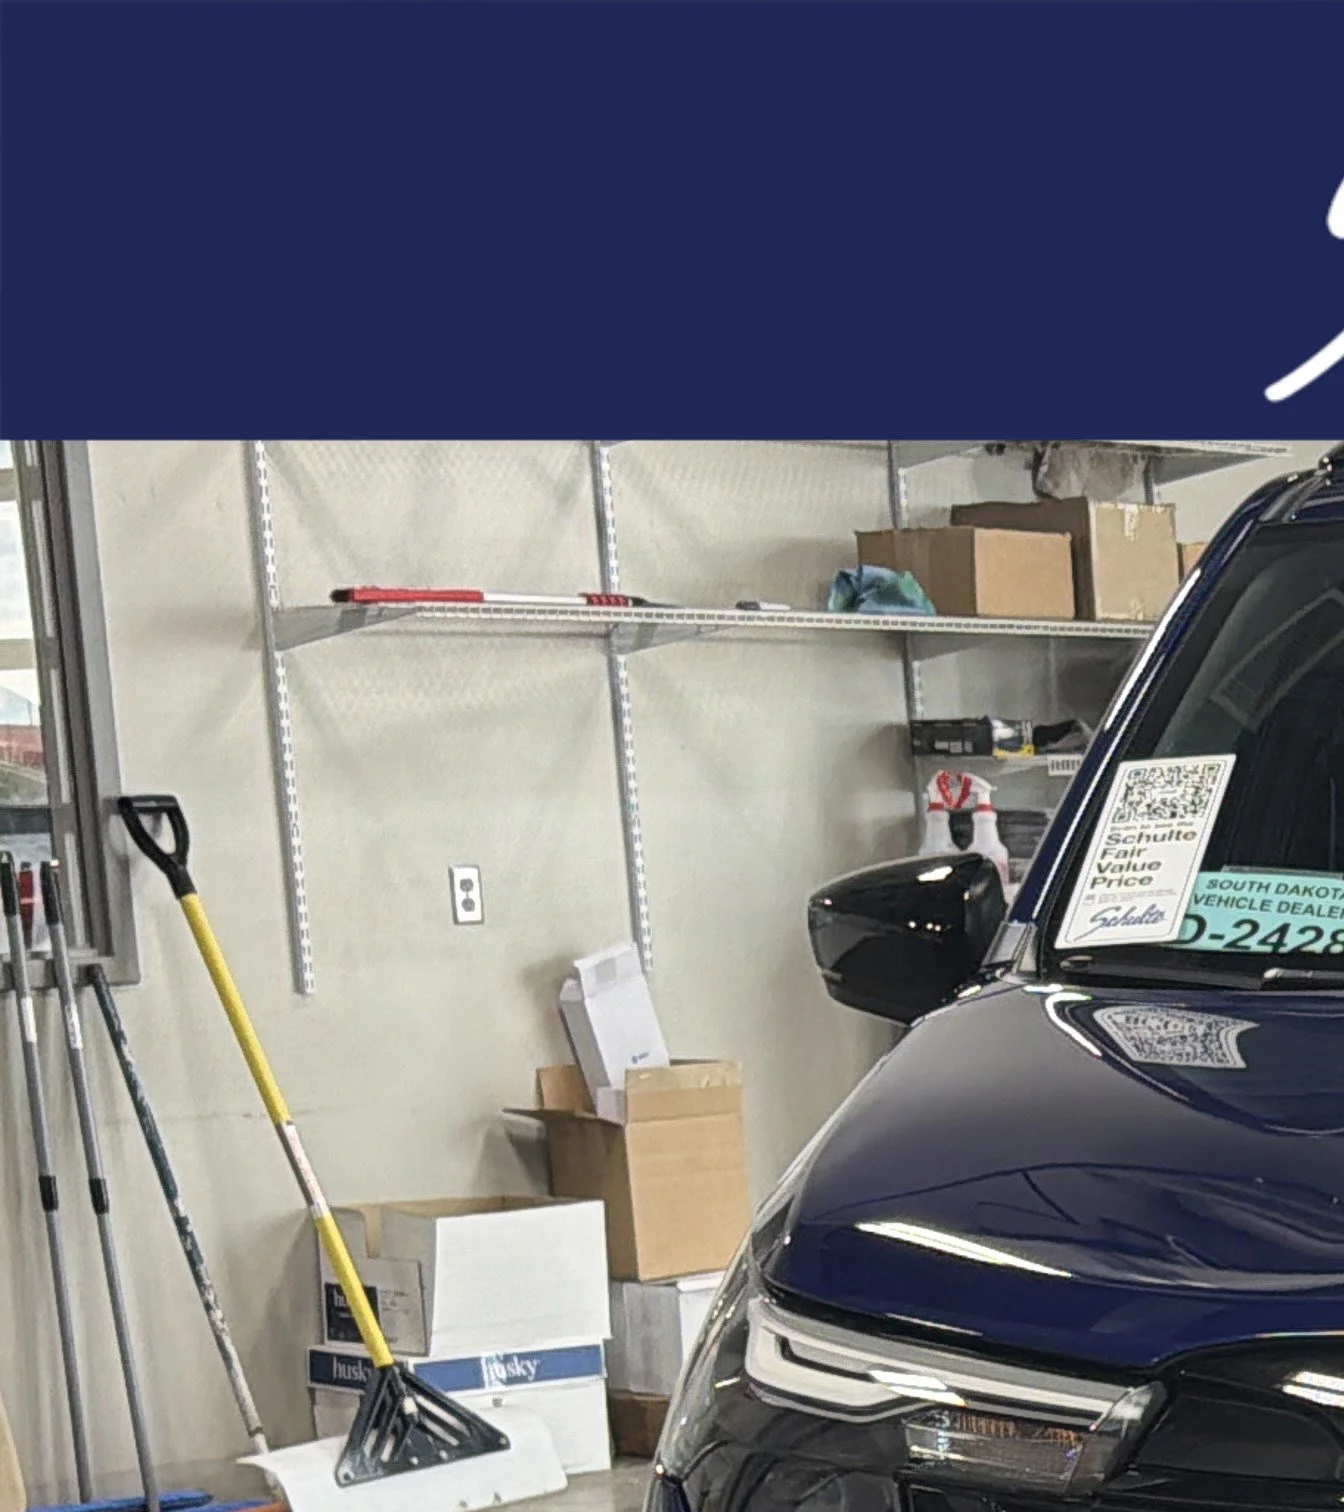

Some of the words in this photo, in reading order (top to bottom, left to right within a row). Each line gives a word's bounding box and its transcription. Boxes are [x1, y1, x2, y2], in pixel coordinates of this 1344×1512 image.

[1105, 829, 1197, 845] Schulte
[1100, 846, 1147, 860] Fair
[1096, 860, 1162, 874] Value
[1090, 875, 1154, 889] Price
[1206, 879, 1271, 894] SOUTH
[1193, 894, 1272, 913] VEHICLE
